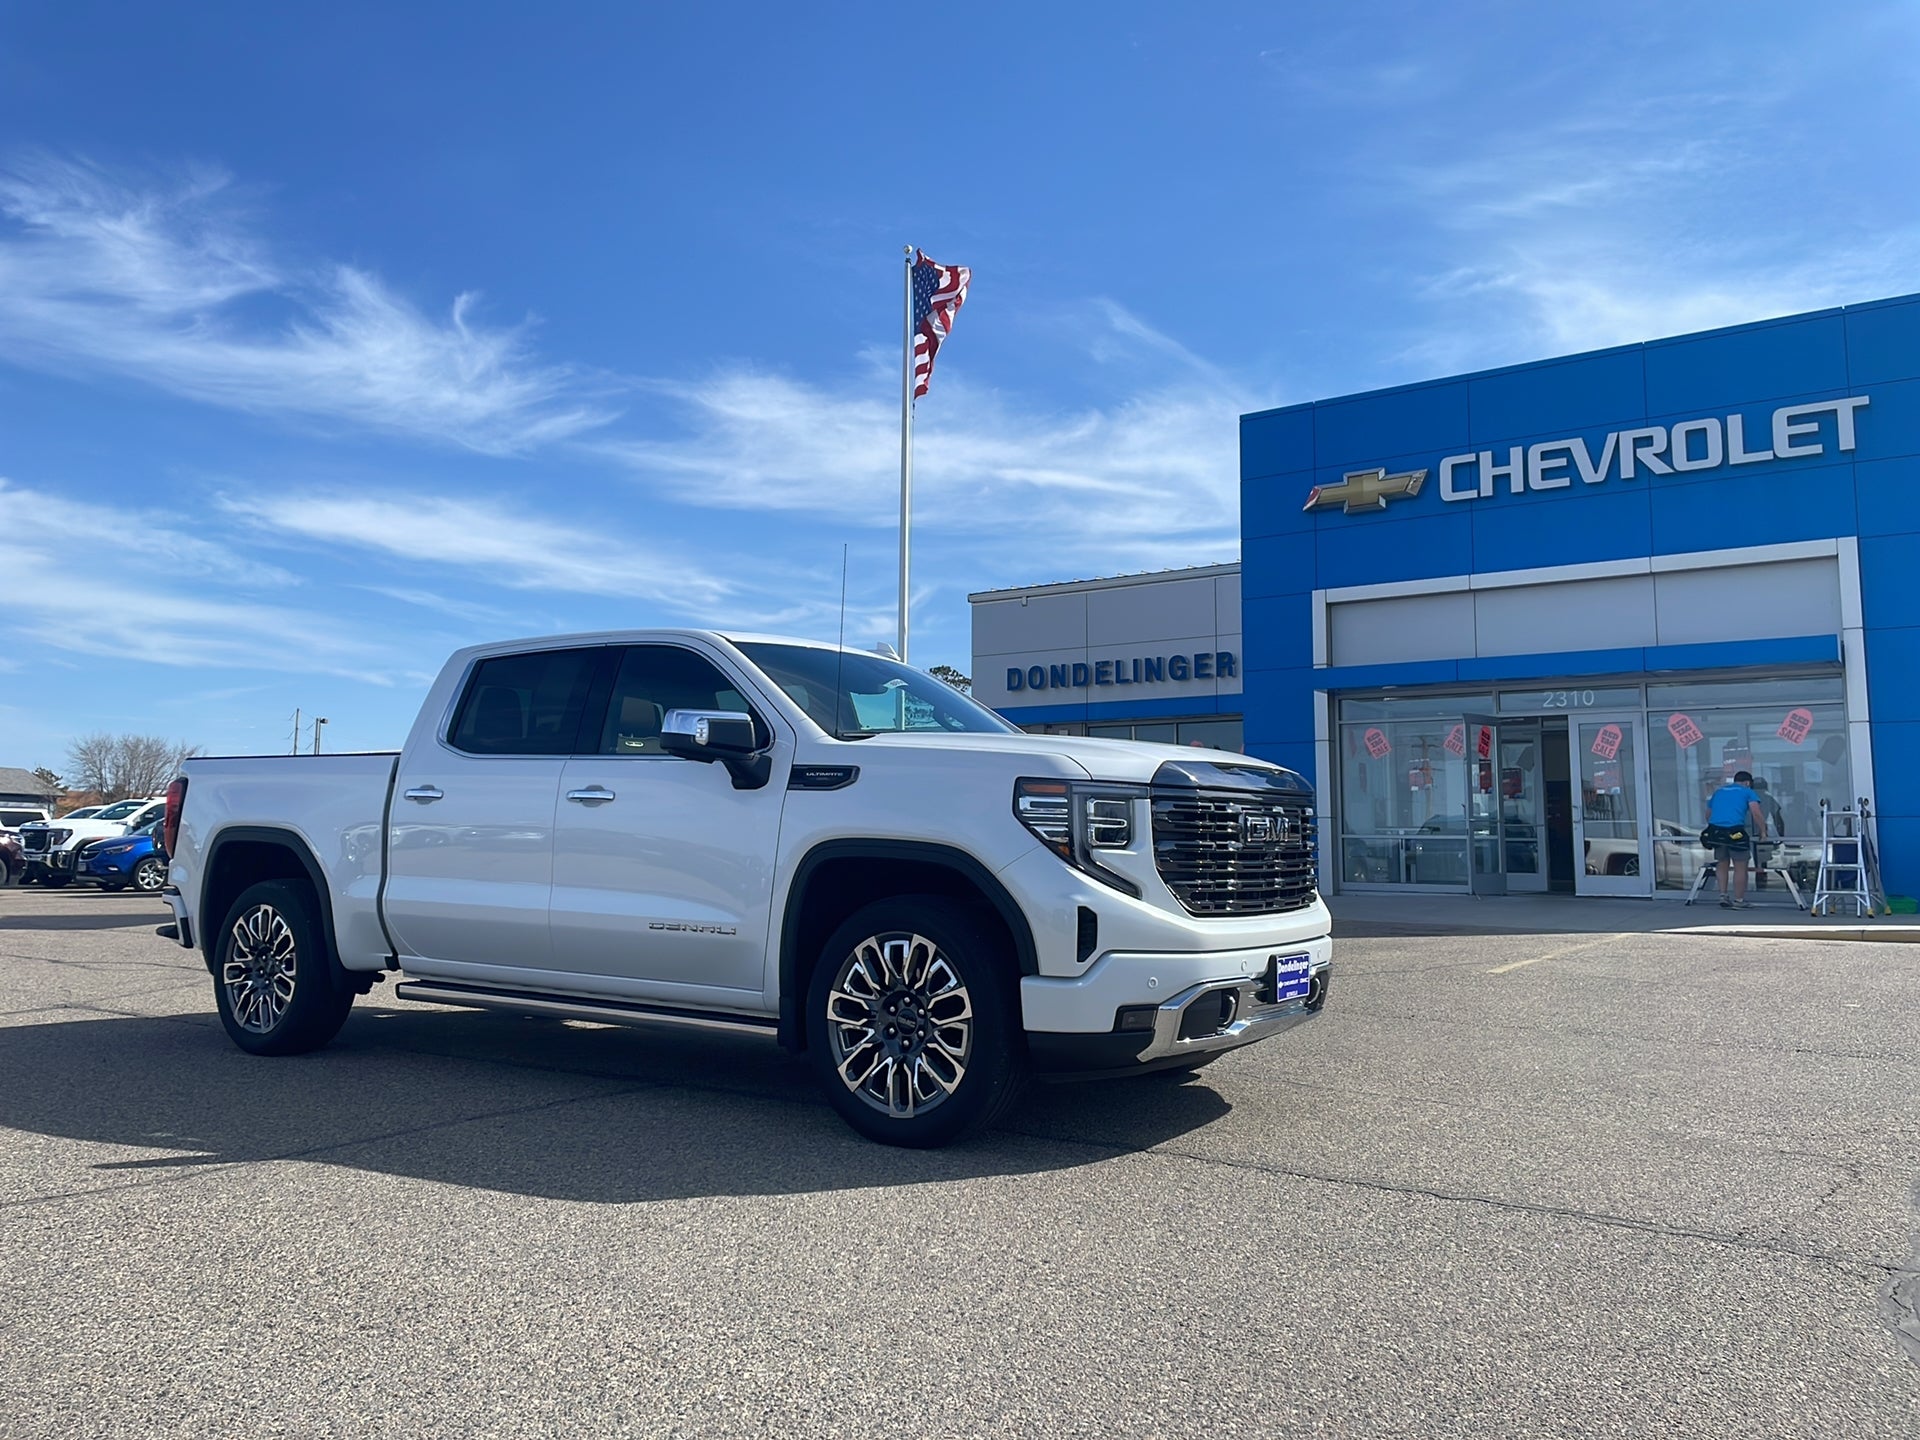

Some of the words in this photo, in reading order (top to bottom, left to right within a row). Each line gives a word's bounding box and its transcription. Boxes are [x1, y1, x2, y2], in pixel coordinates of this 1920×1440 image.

[1439, 395, 1869, 502] CHEVROLET
[1006, 651, 1237, 692] DONDELINGER
[1543, 689, 1595, 707] 2310
[1680, 730, 1701, 746] SALE
[1779, 727, 1802, 744] SALE
[1593, 743, 1614, 758] SALE
[649, 922, 736, 936] DENALI
[1278, 960, 1309, 974] Dondelinger
